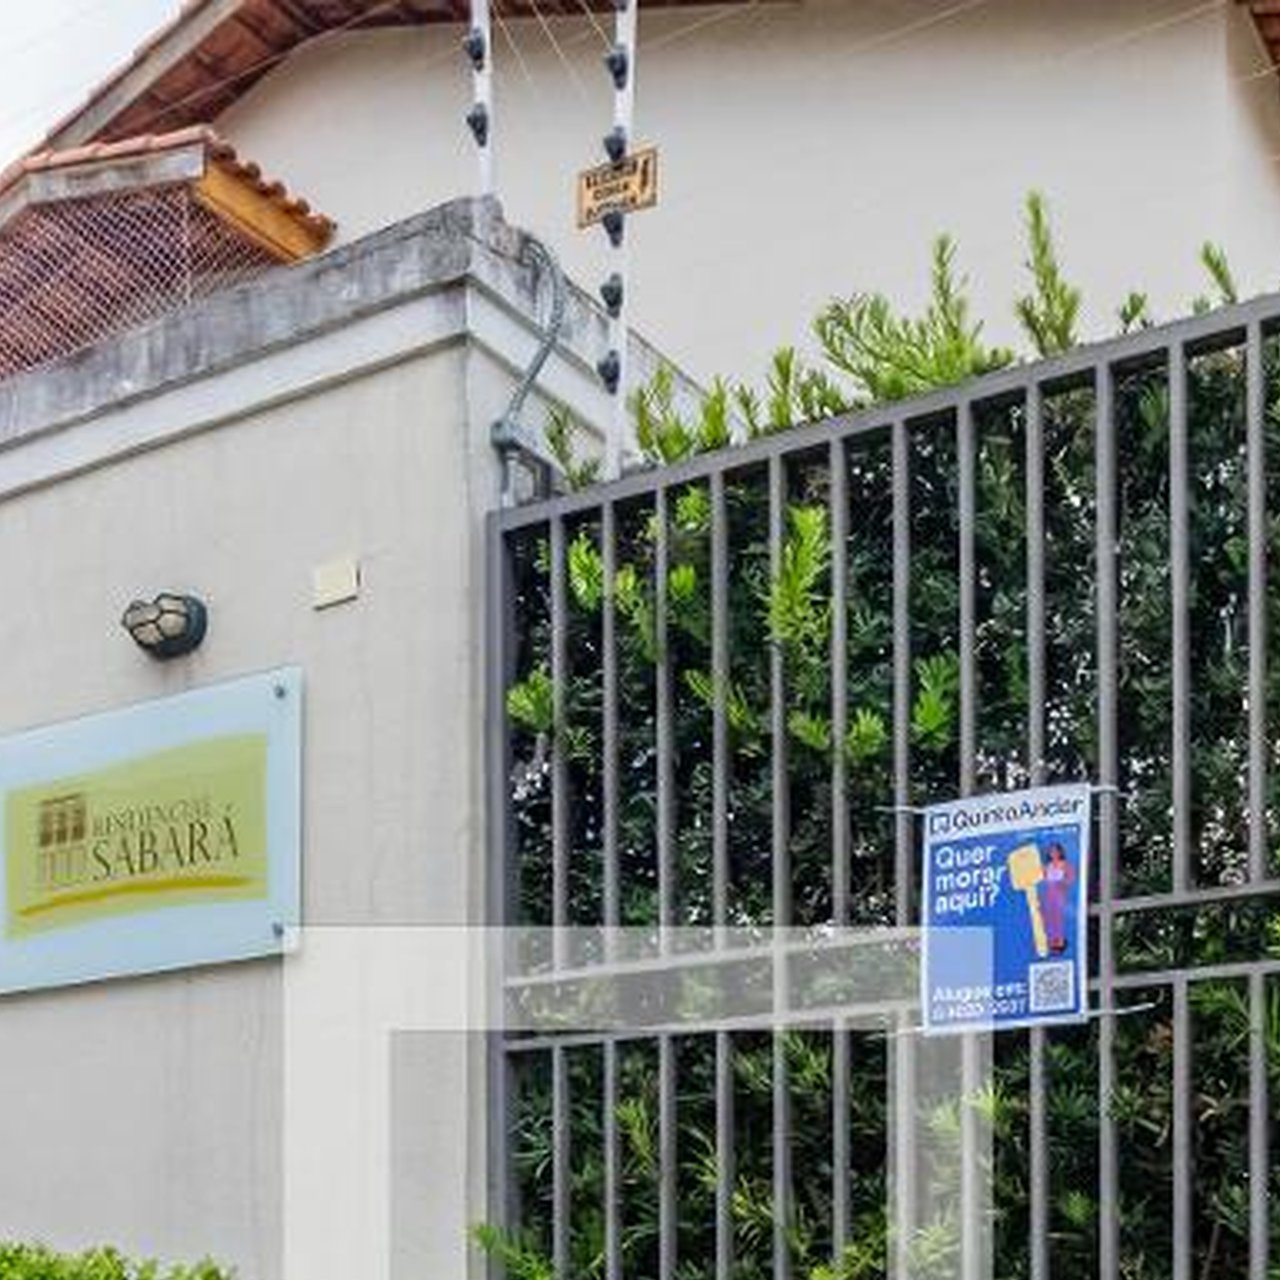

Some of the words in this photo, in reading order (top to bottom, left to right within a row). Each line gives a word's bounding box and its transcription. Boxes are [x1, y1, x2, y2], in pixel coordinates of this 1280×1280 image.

[91, 803, 239, 881] SABARÁ
[935, 845, 998, 869] Quer
[935, 865, 1007, 893] morar
[934, 884, 1000, 915] aqui?
